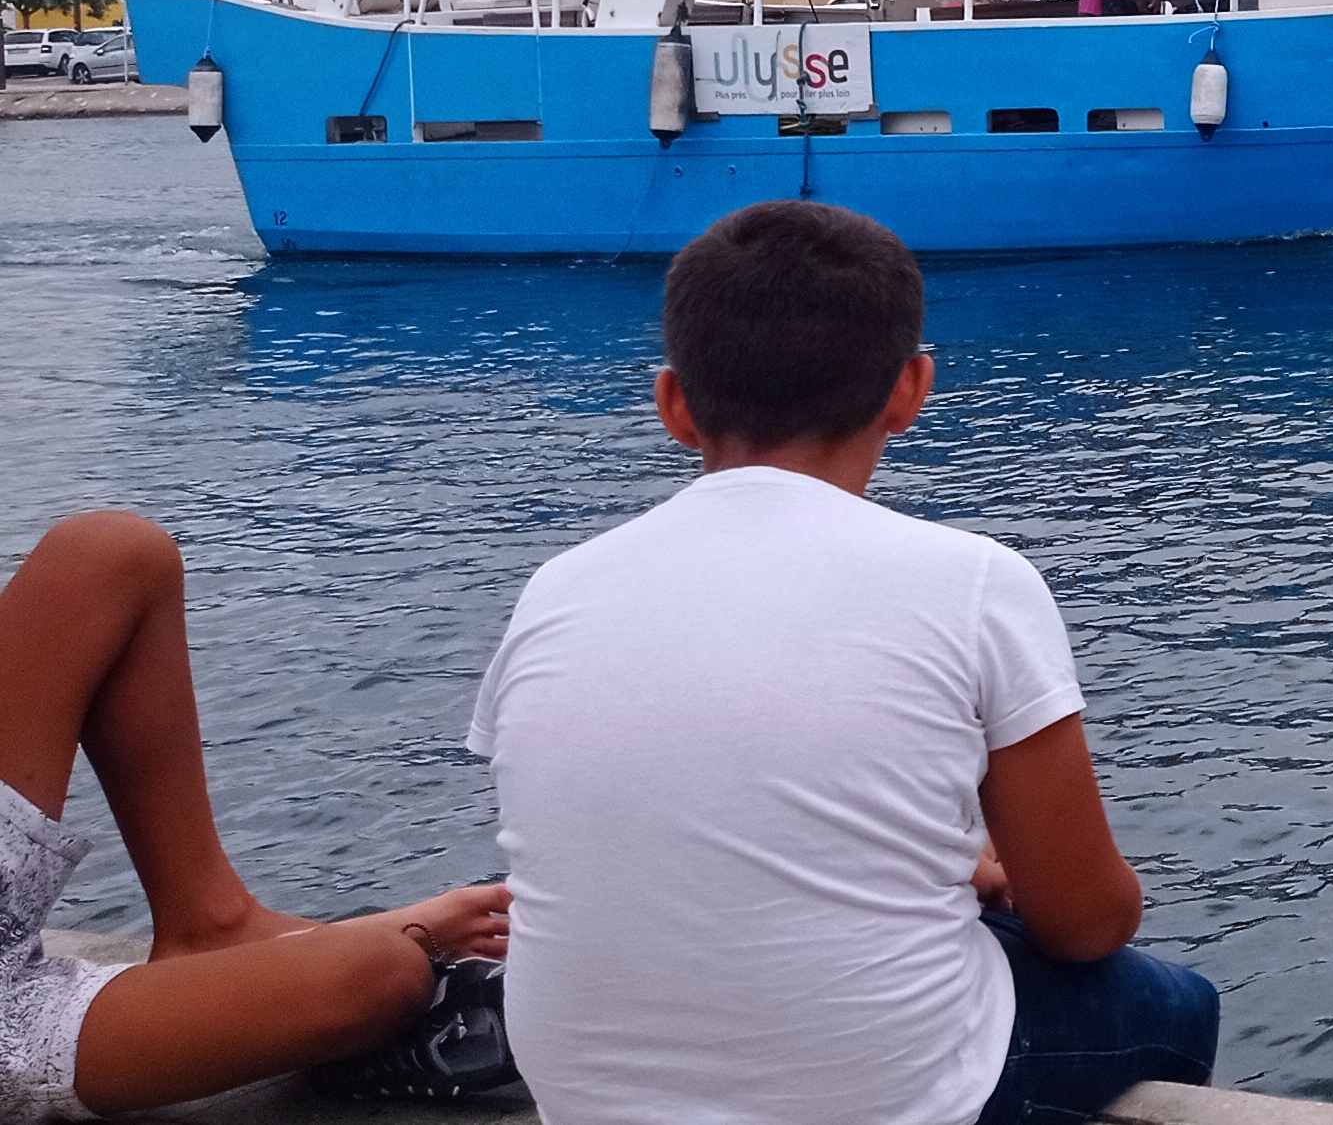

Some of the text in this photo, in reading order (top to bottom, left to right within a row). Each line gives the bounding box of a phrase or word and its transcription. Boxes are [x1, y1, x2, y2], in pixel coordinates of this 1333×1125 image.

[713, 33, 849, 102] ulysse
[715, 91, 730, 99] Plus
[781, 91, 797, 100] pour
[801, 89, 816, 98] ller
[818, 89, 834, 99] plus
[836, 89, 850, 97] loin
[273, 210, 288, 226] 12
